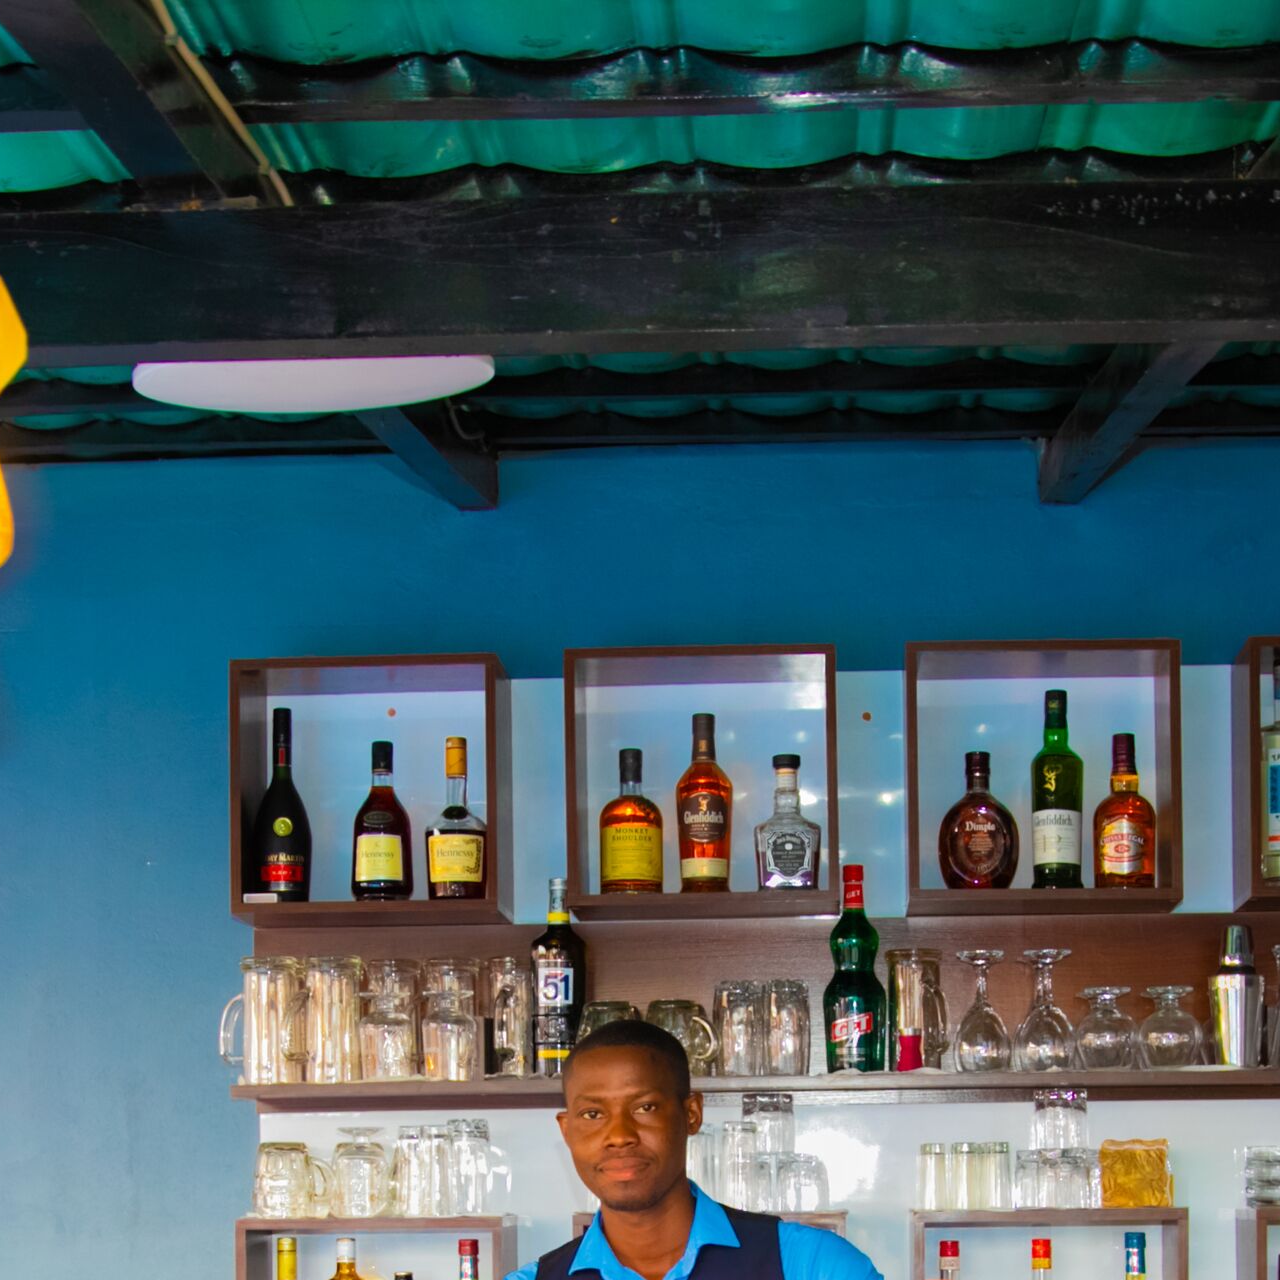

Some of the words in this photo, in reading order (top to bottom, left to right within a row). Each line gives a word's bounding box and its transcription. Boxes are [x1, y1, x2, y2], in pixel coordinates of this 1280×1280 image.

[683, 811, 725, 825] Glenfiddich
[964, 821, 997, 833] Dimple
[611, 834, 653, 842] SHOULDER
[360, 848, 395, 859] Hennessy
[436, 847, 475, 858] Hennessy
[845, 890, 862, 899] GET
[542, 973, 571, 1001] 51
[833, 1015, 869, 1037] GET
